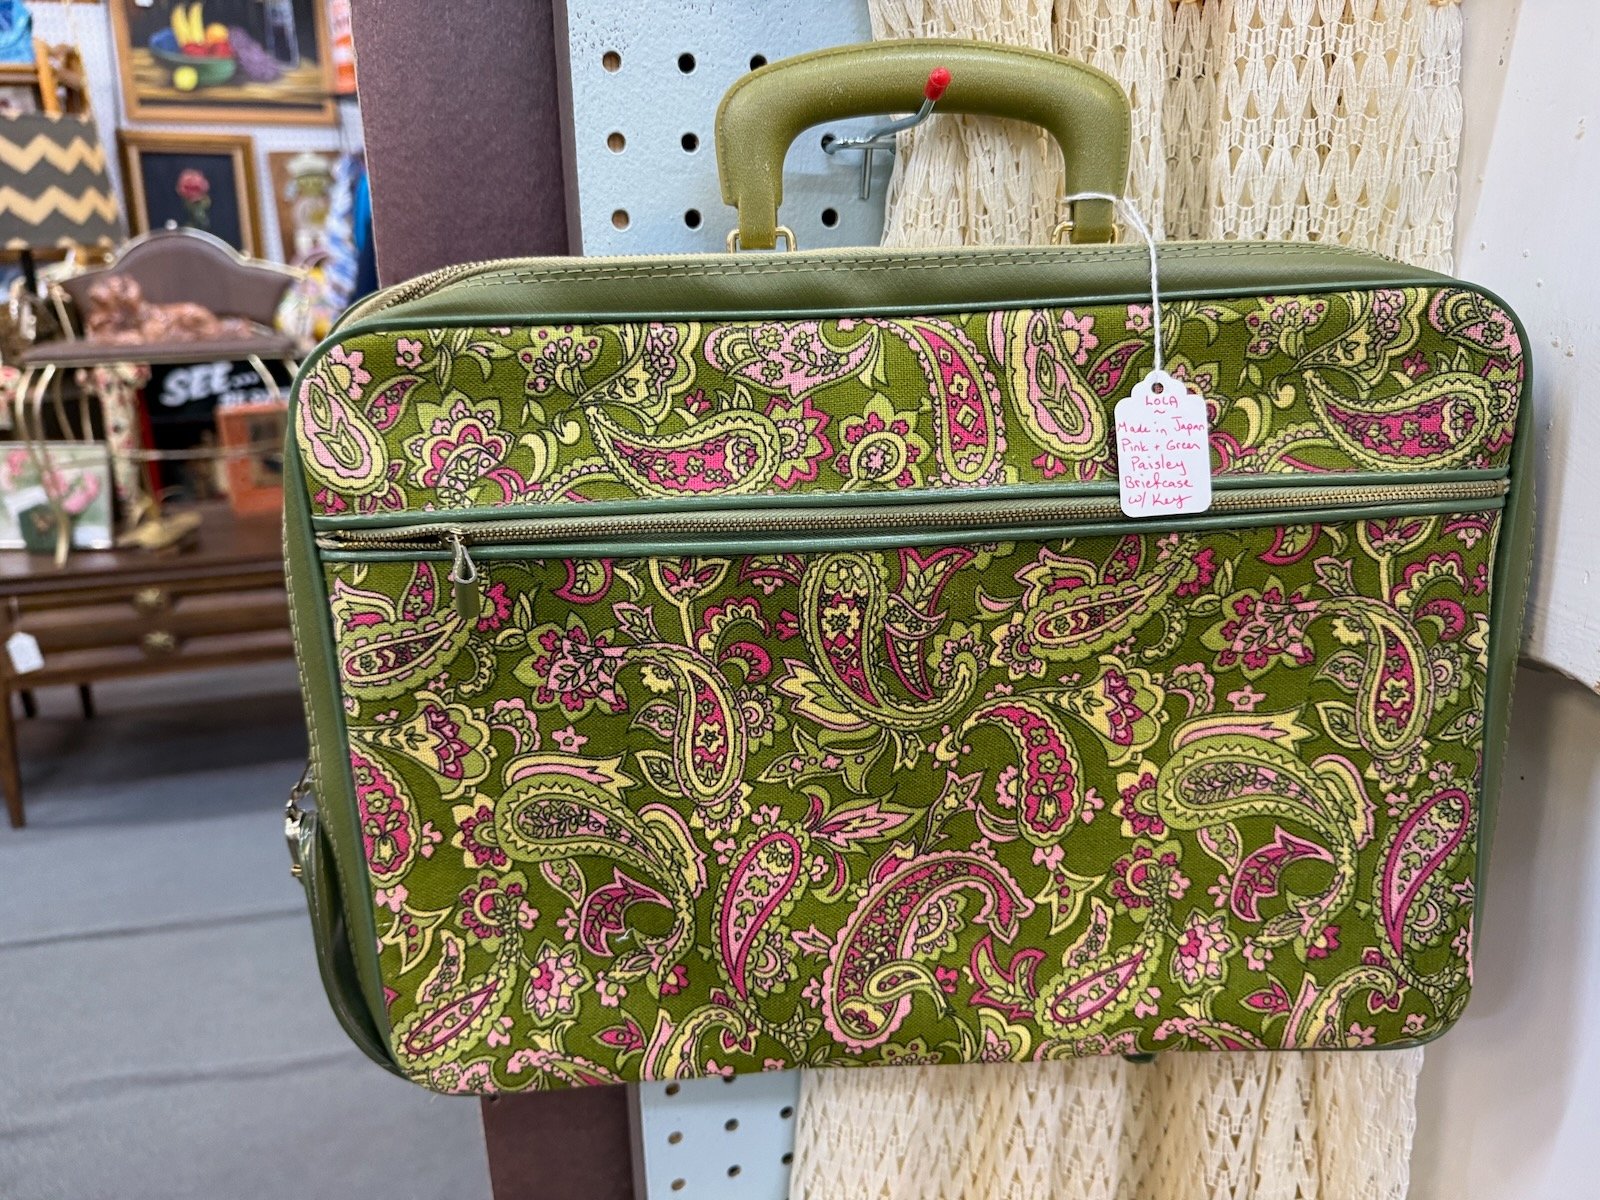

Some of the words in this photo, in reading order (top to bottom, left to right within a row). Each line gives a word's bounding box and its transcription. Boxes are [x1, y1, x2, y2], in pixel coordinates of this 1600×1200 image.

[1117, 421, 1151, 433] Made
[1153, 421, 1167, 436] in
[1171, 416, 1205, 436] Japan
[1121, 438, 1149, 452] Pink
[1166, 440, 1201, 450] Green
[1131, 454, 1187, 476] Paisley
[1124, 472, 1193, 489] Briefcase
[1128, 492, 1146, 508] w/
[1152, 493, 1192, 509] Key
